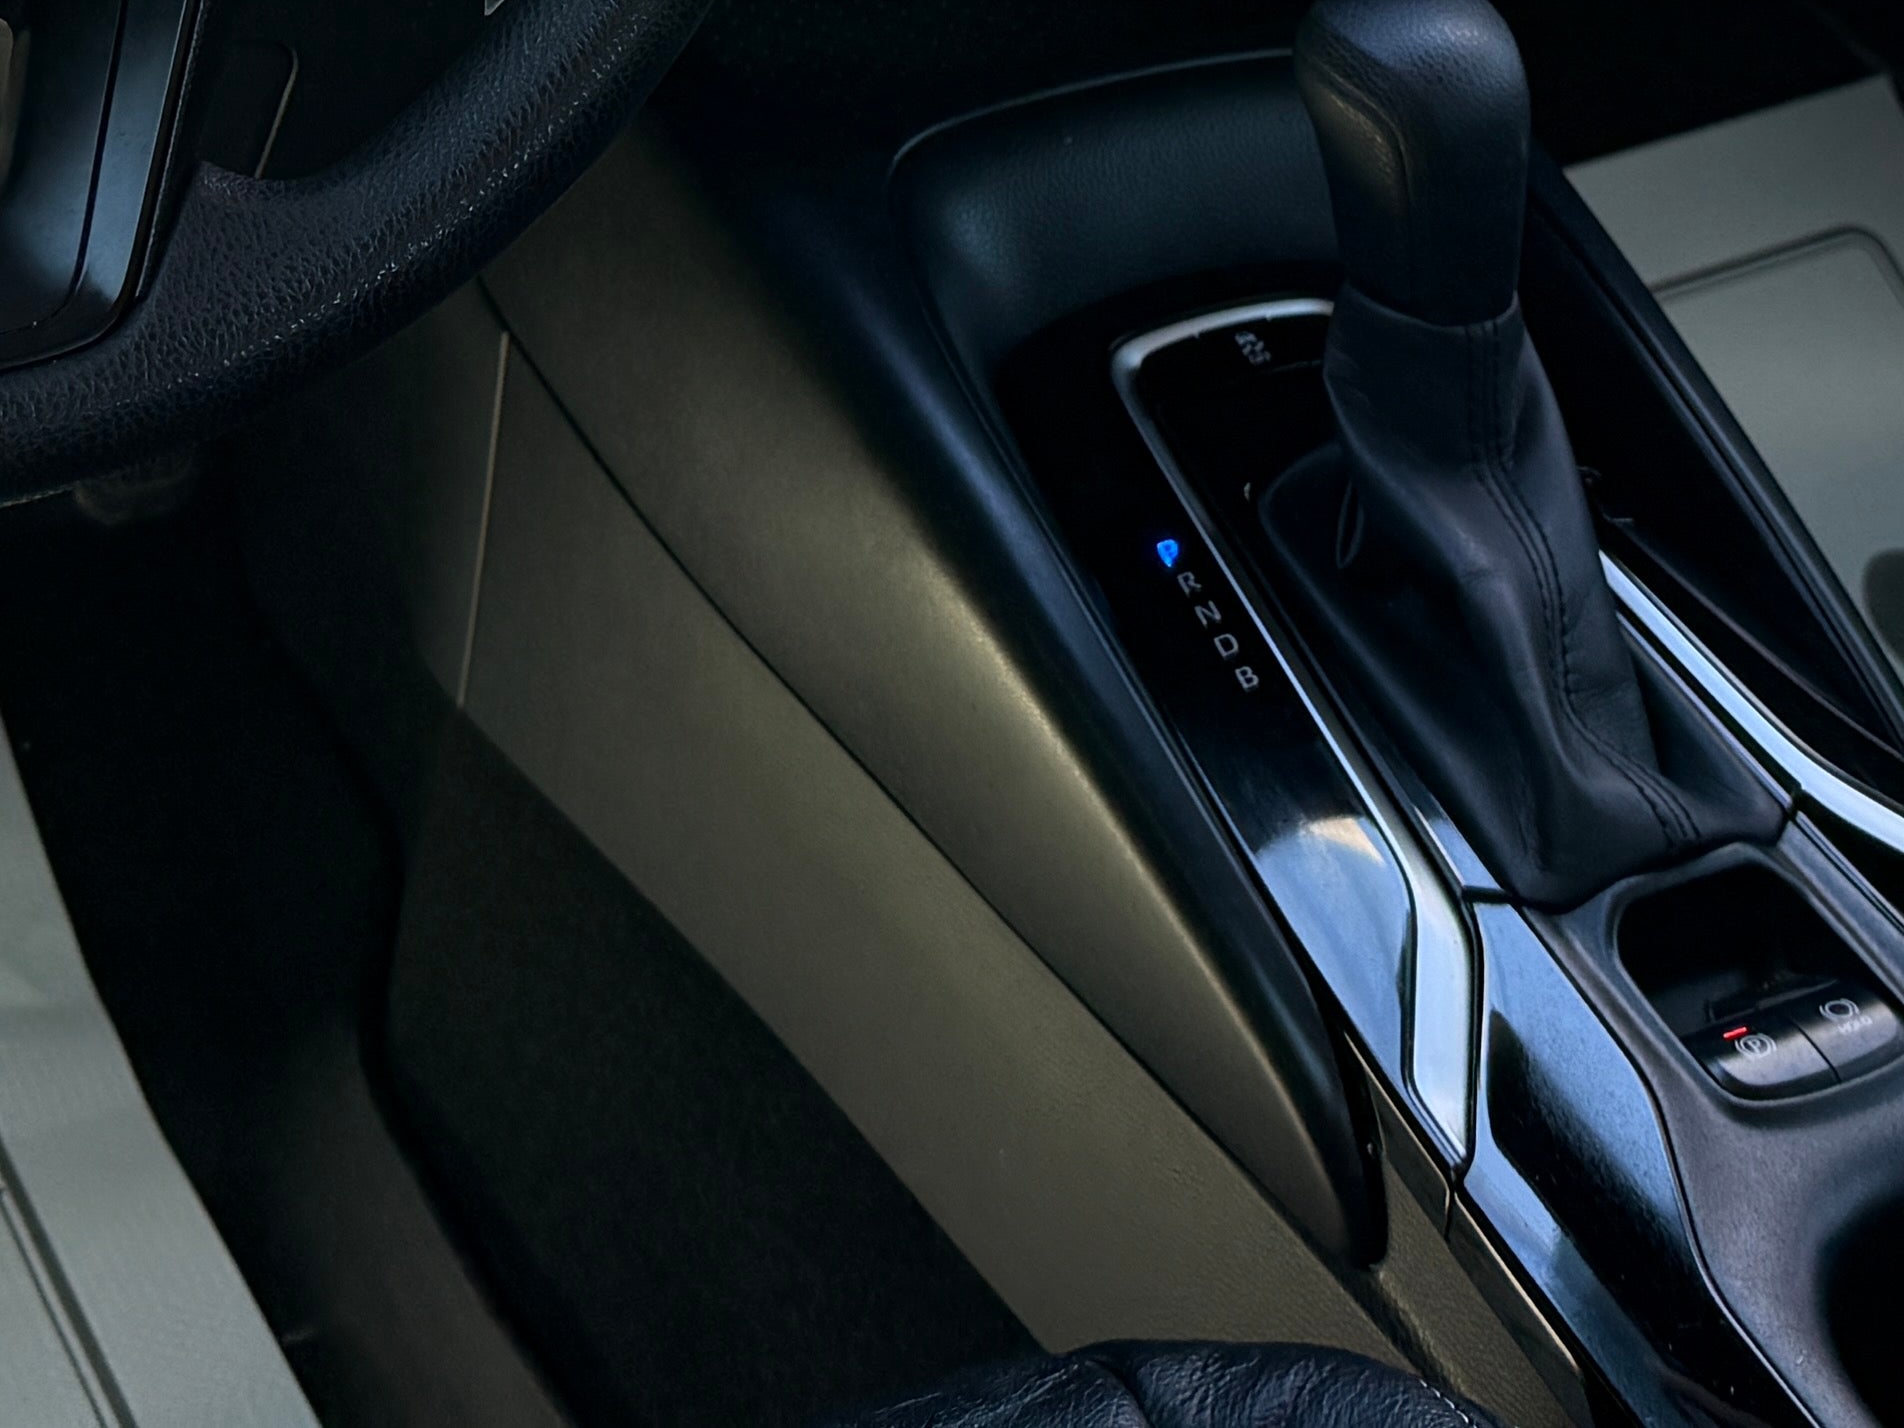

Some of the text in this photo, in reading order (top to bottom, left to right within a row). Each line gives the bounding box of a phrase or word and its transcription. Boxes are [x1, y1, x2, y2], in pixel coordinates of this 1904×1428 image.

[1177, 570, 1202, 599] R
[1194, 600, 1223, 629] N
[1214, 632, 1239, 661] D
[1234, 665, 1260, 693] B
